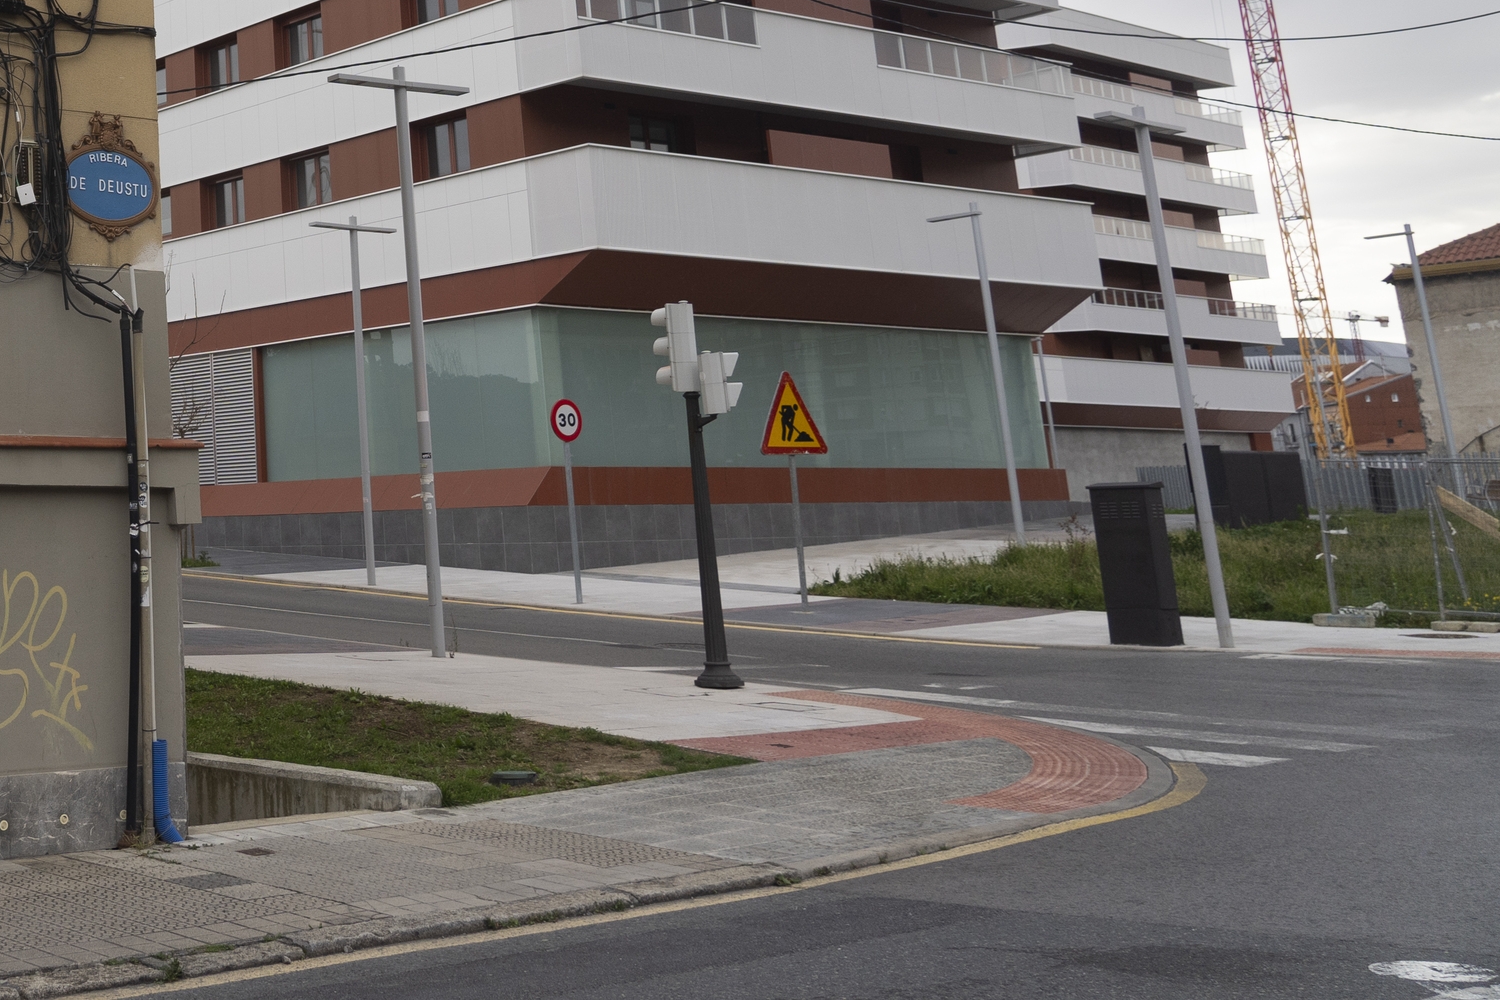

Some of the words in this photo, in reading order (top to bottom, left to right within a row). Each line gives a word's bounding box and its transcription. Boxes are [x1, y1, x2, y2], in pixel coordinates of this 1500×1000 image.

[88, 152, 128, 167] RIBERA
[70, 175, 87, 190] DE
[98, 178, 148, 198] DEUSTU
[558, 412, 576, 427] 30
